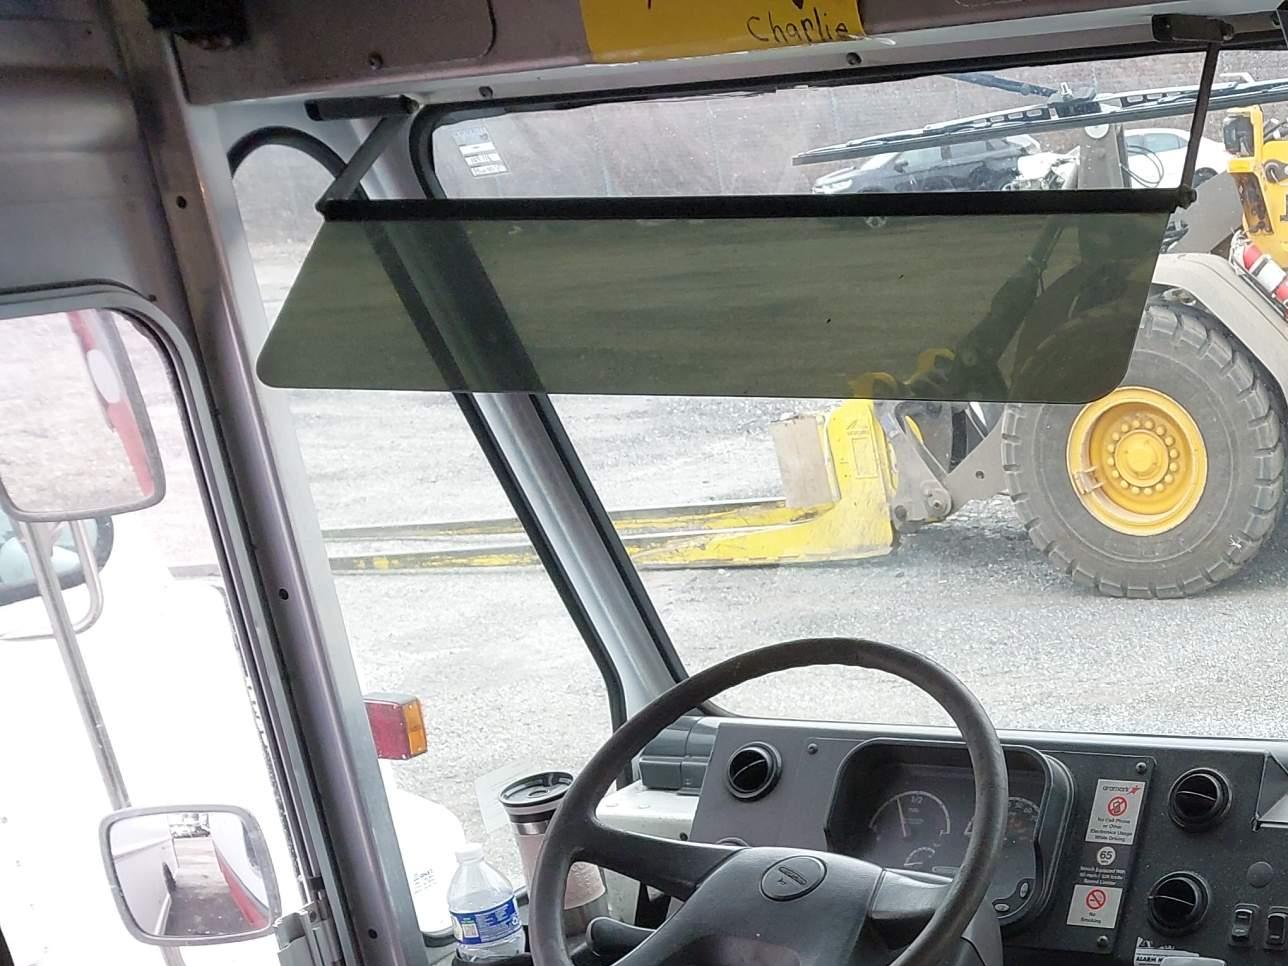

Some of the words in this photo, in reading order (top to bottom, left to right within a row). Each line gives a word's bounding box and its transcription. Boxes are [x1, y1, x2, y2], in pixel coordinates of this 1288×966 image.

[746, 7, 849, 43] Charlie
[1103, 785, 1129, 793] aramark
[1099, 850, 1113, 860] 65
